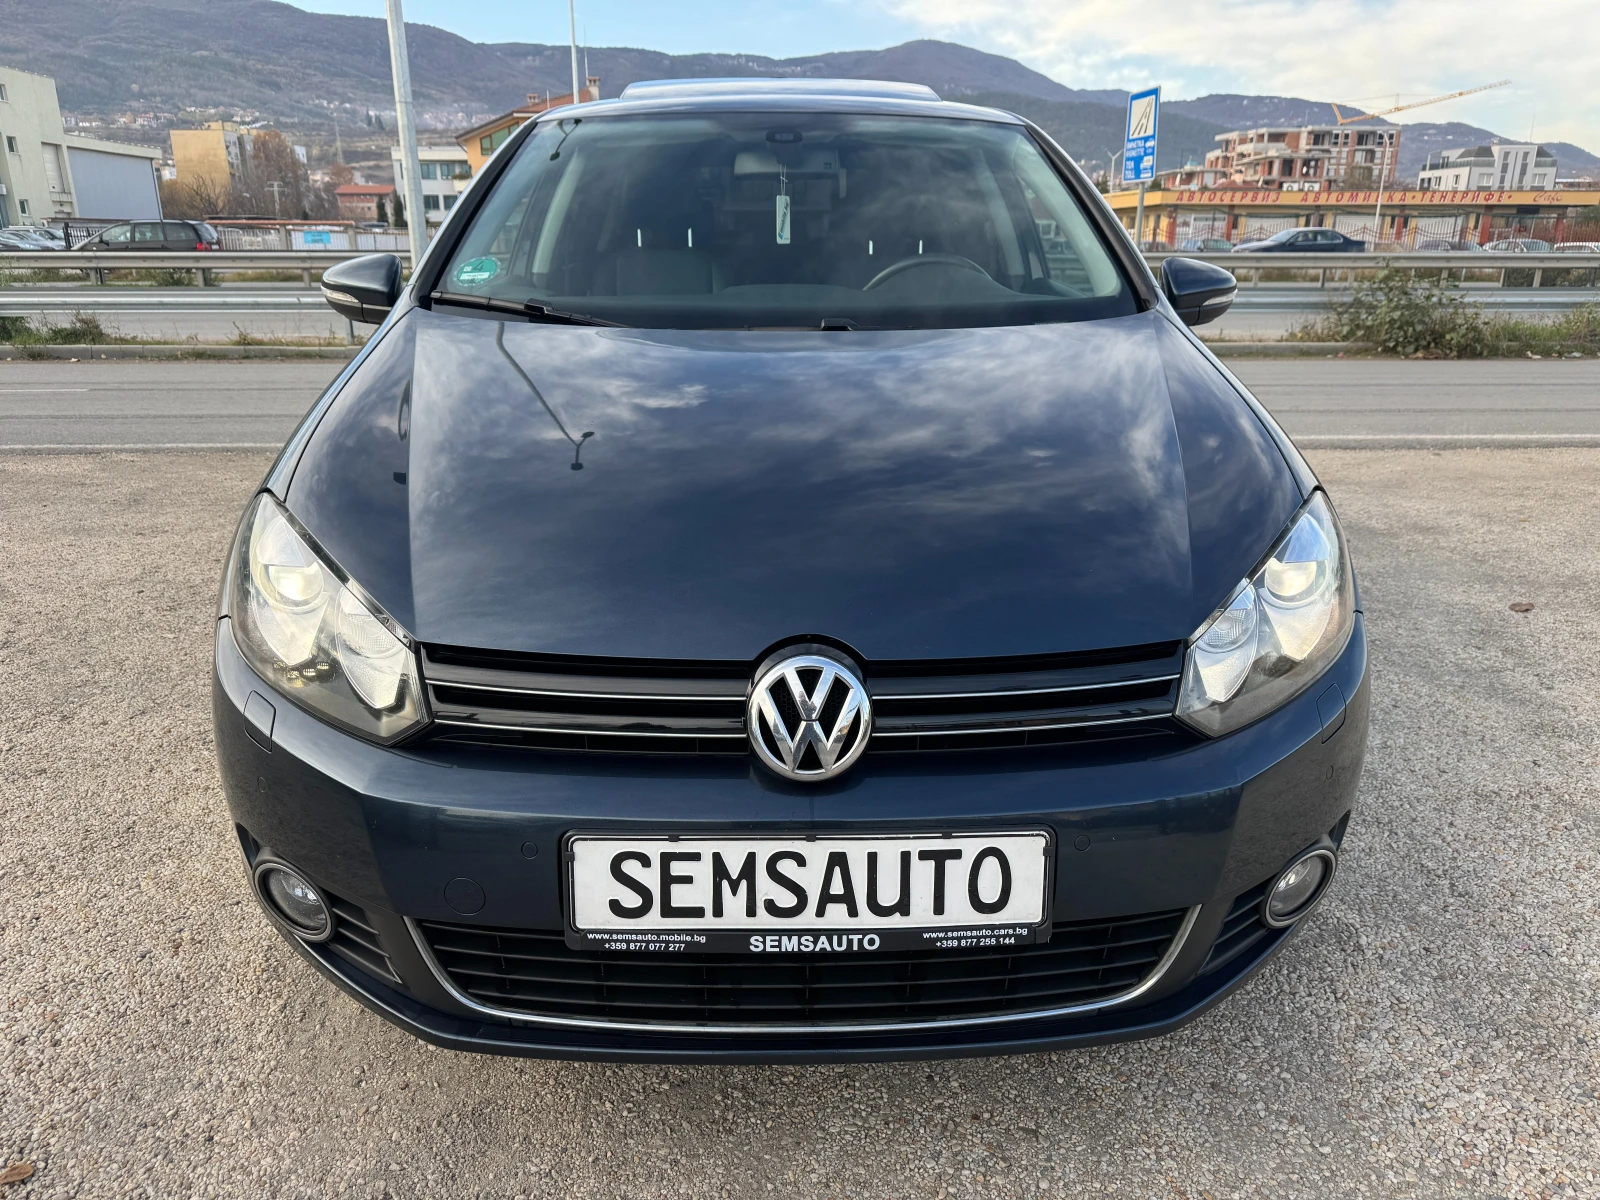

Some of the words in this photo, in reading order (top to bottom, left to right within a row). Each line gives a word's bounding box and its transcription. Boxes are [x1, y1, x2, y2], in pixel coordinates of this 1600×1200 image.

[1176, 191, 1281, 203] АВТОСЕРВИЗ
[1420, 191, 1505, 203] ТЕНЕРИФЕ
[608, 846, 1013, 919] SEMSAUTO
[587, 932, 707, 943] www.semsauto.mobile.bg
[923, 927, 1028, 939] www.semsauto.cars.bg
[604, 942, 627, 950] +359
[649, 943, 666, 951] 077
[668, 943, 686, 951] 277
[749, 934, 880, 952] SEMSAUTO
[936, 939, 958, 948] +359
[961, 938, 978, 947] 877
[980, 938, 997, 946] 255
[999, 936, 1015, 945] 144
